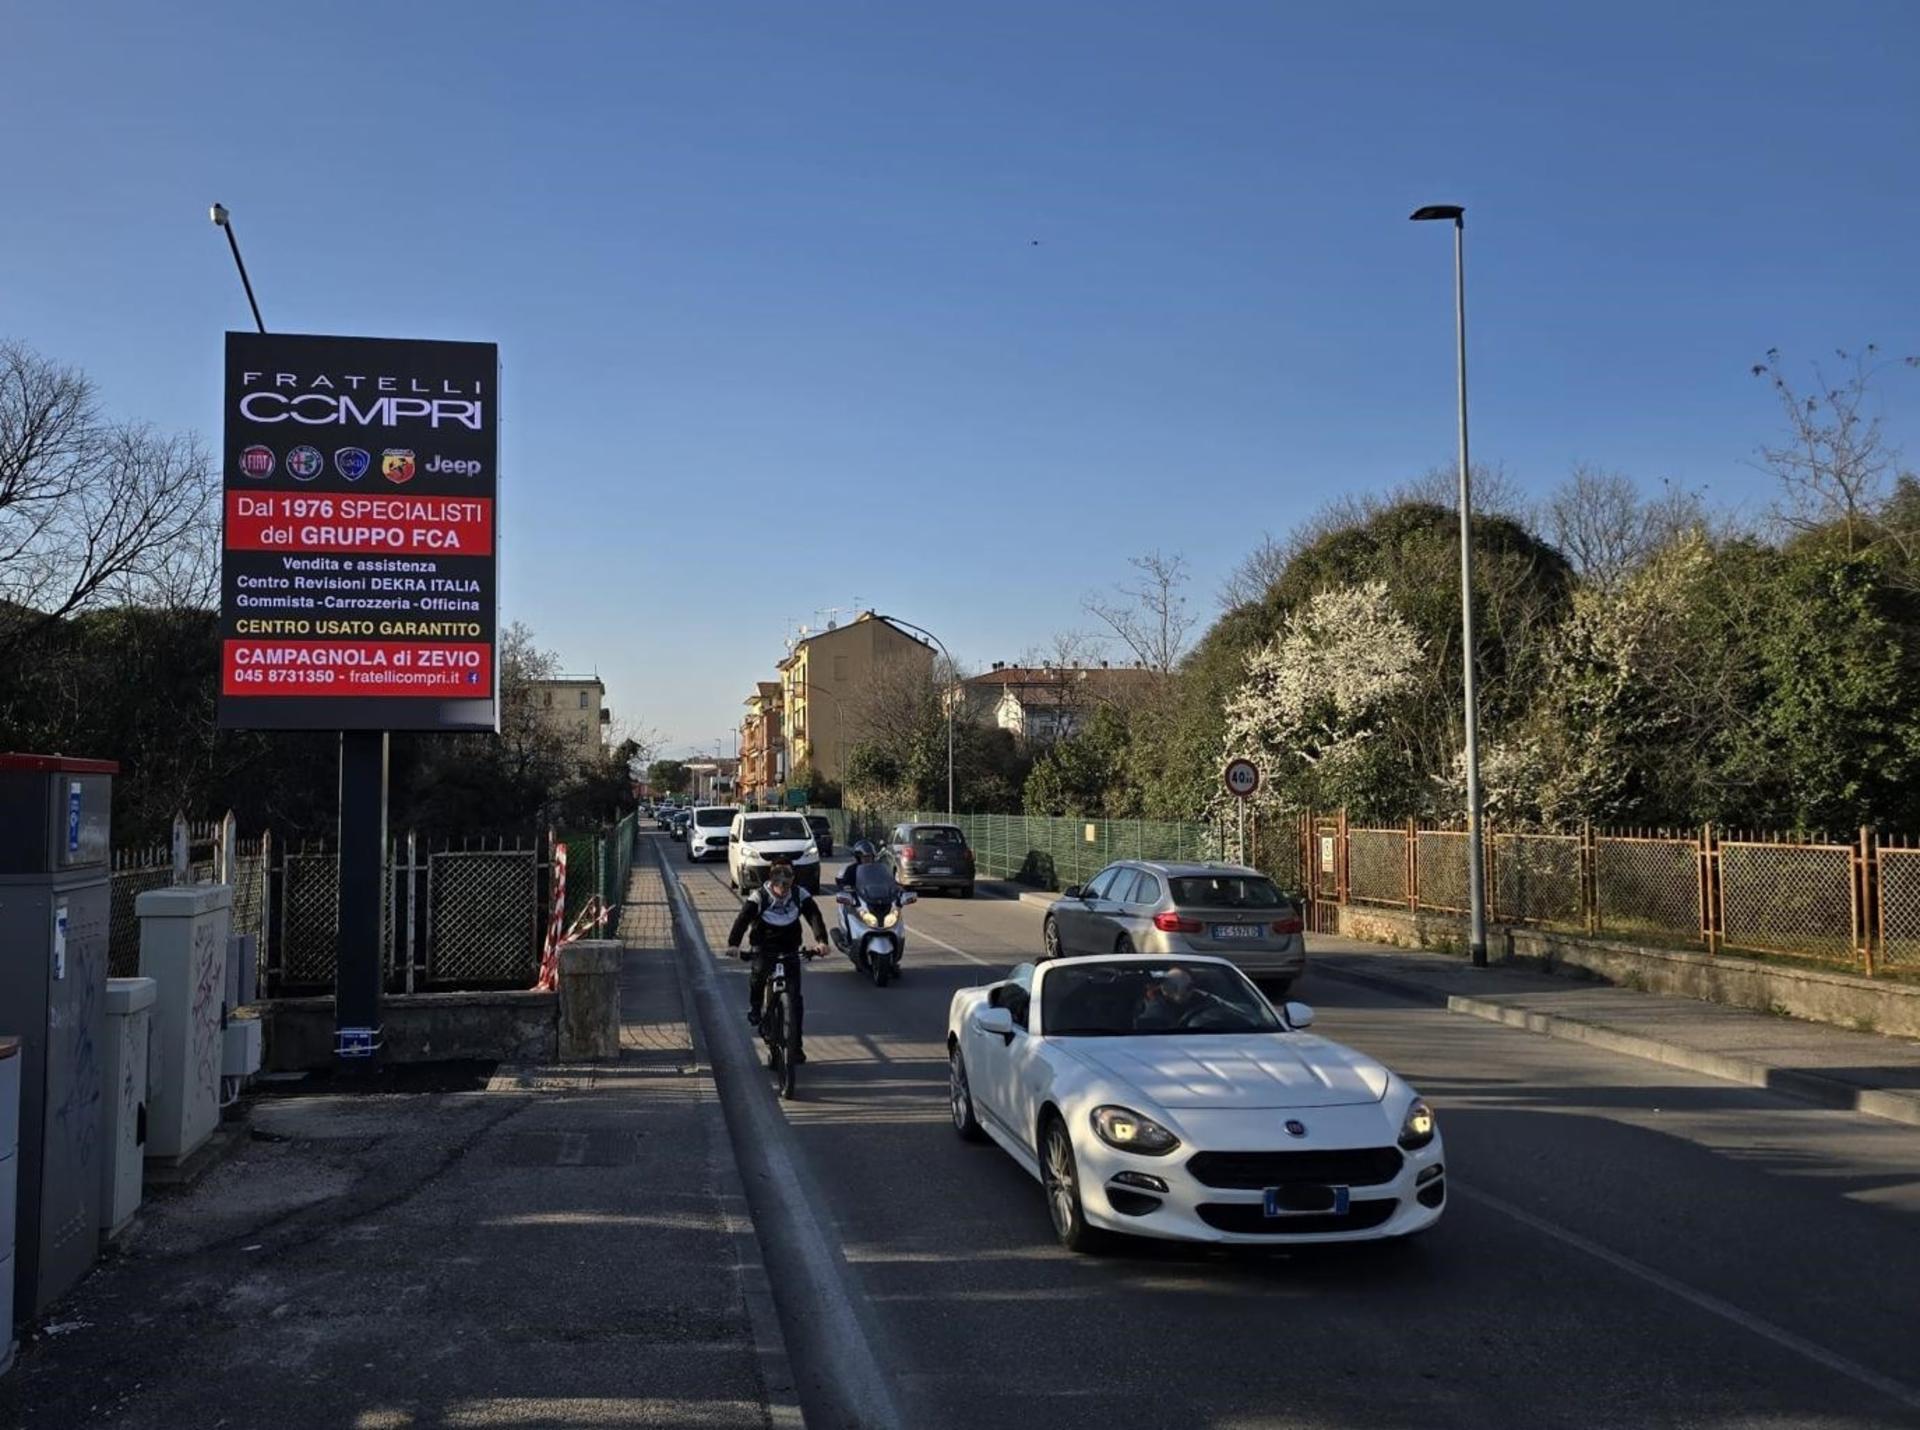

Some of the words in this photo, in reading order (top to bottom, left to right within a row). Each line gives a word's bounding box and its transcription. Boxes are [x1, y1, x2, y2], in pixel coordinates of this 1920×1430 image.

[243, 372, 481, 394] FRATELLI
[239, 392, 481, 430] COMPRI
[425, 454, 481, 477] Jeep
[238, 498, 273, 517] Dal
[281, 500, 333, 518] 1976
[340, 501, 482, 522] SPECIALISTI
[261, 526, 293, 545] del
[301, 527, 404, 547] GRUPPO
[413, 530, 460, 548] FCA
[283, 558, 339, 570] Vendita
[343, 560, 353, 571] e
[357, 560, 436, 572] assistenza
[237, 576, 289, 588] Centro
[294, 577, 366, 590] Revisioni
[371, 578, 426, 591] DEKRA
[431, 580, 480, 592] ITALIA
[236, 620, 310, 634] CENTRO
[316, 621, 374, 635] USATO
[379, 622, 481, 636] GARANTITO
[235, 648, 386, 665] CAMPAGNOLA
[393, 649, 411, 665] di
[418, 651, 480, 667] ZEVIO
[234, 670, 263, 682] 045
[268, 670, 334, 683] 8731350
[350, 671, 460, 686] fratellicompri.it
[1232, 771, 1245, 784] 40
